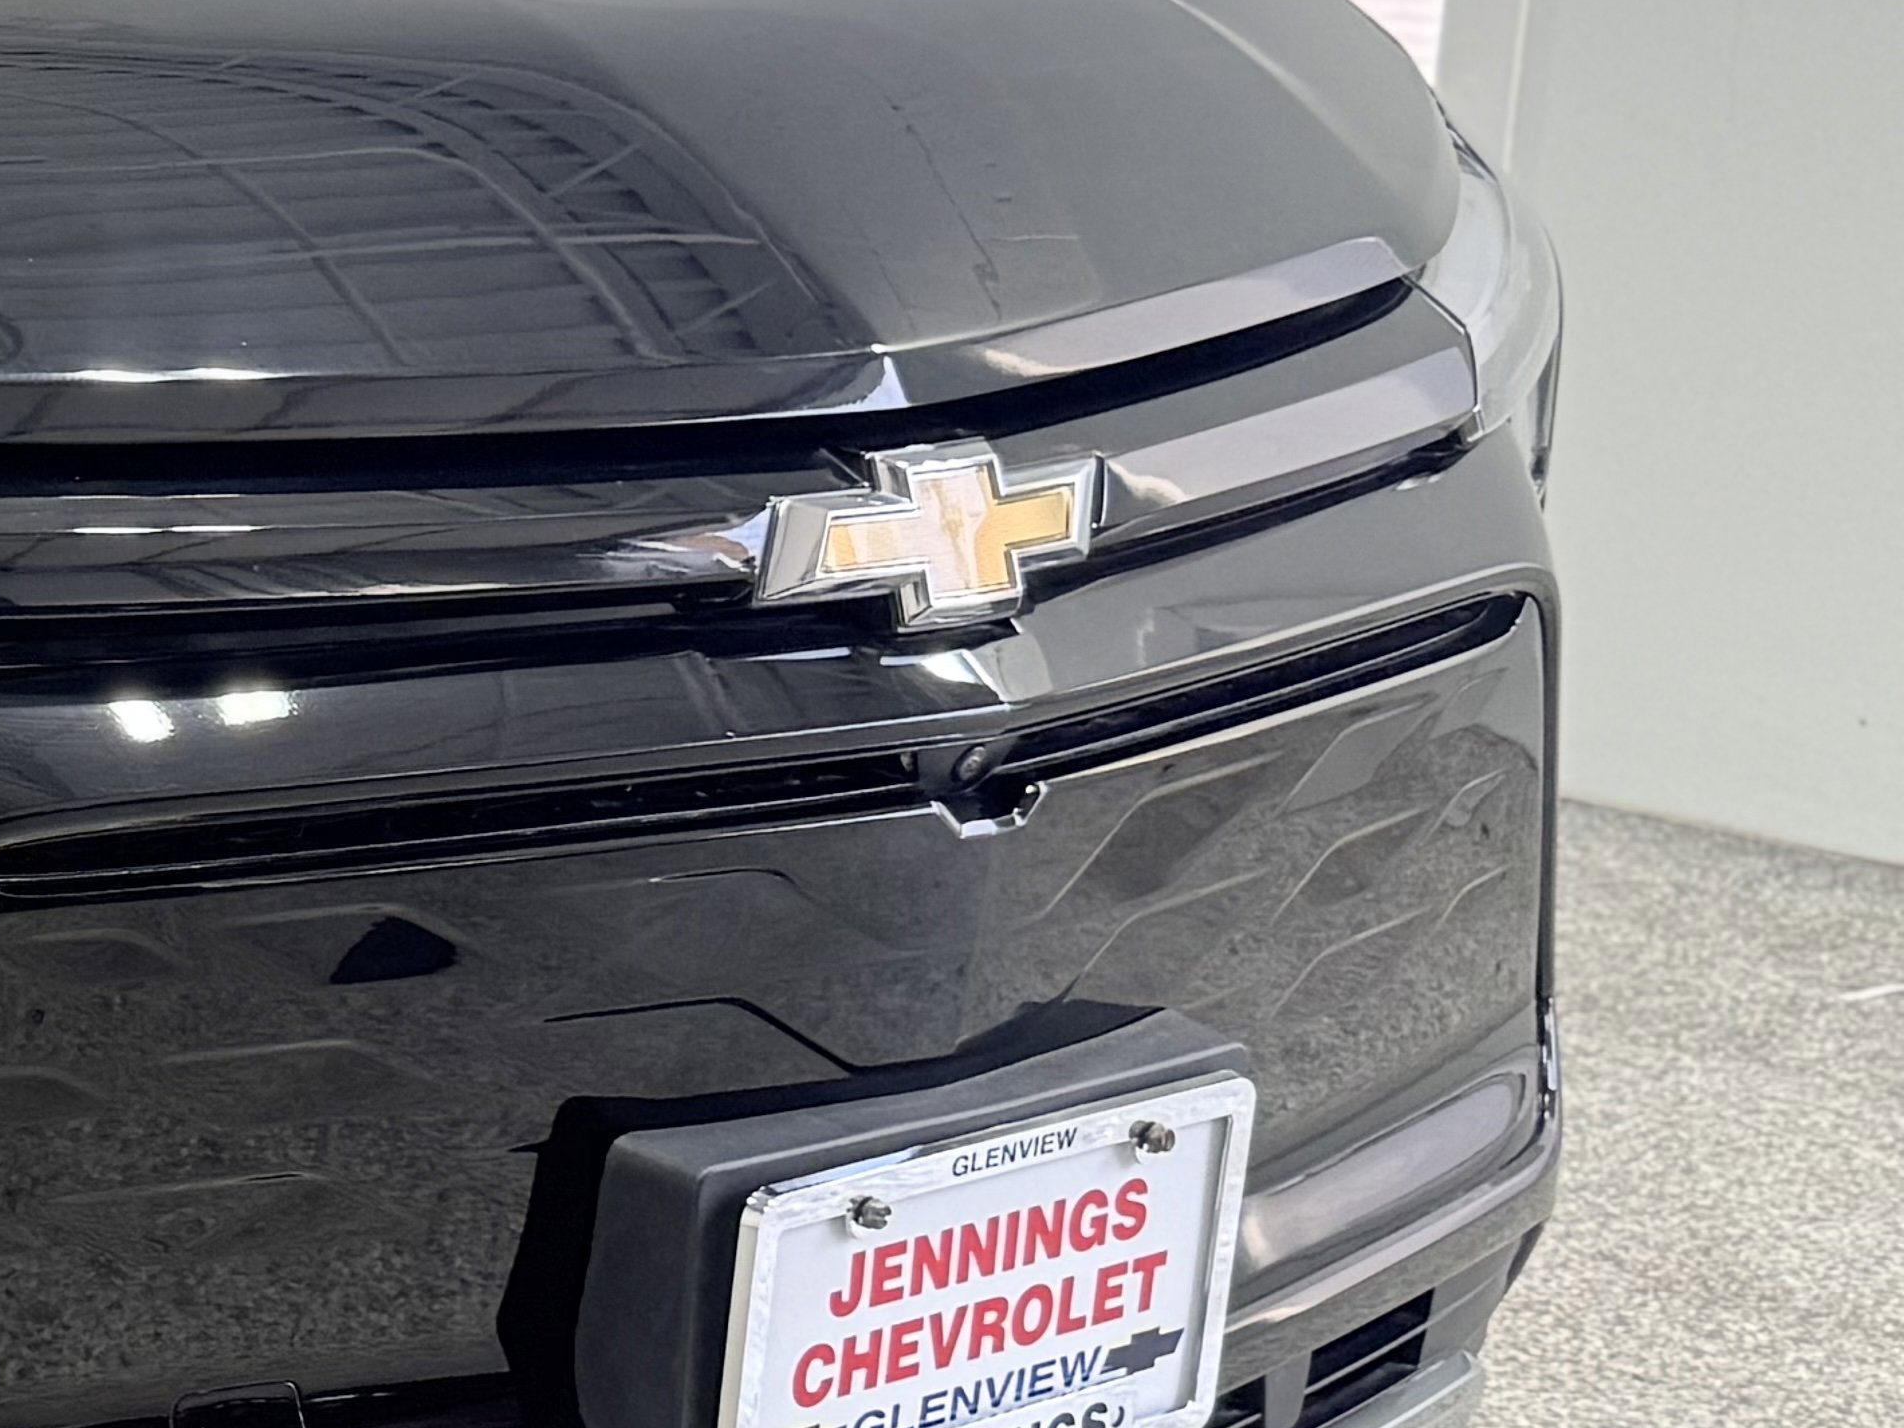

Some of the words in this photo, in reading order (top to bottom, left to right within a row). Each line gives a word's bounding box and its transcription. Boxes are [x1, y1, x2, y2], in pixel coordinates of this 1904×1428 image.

[952, 1127, 1078, 1177] GLENVIEW
[829, 1178, 1149, 1317] JENNINGS
[792, 1251, 1168, 1408] CHEVROLET
